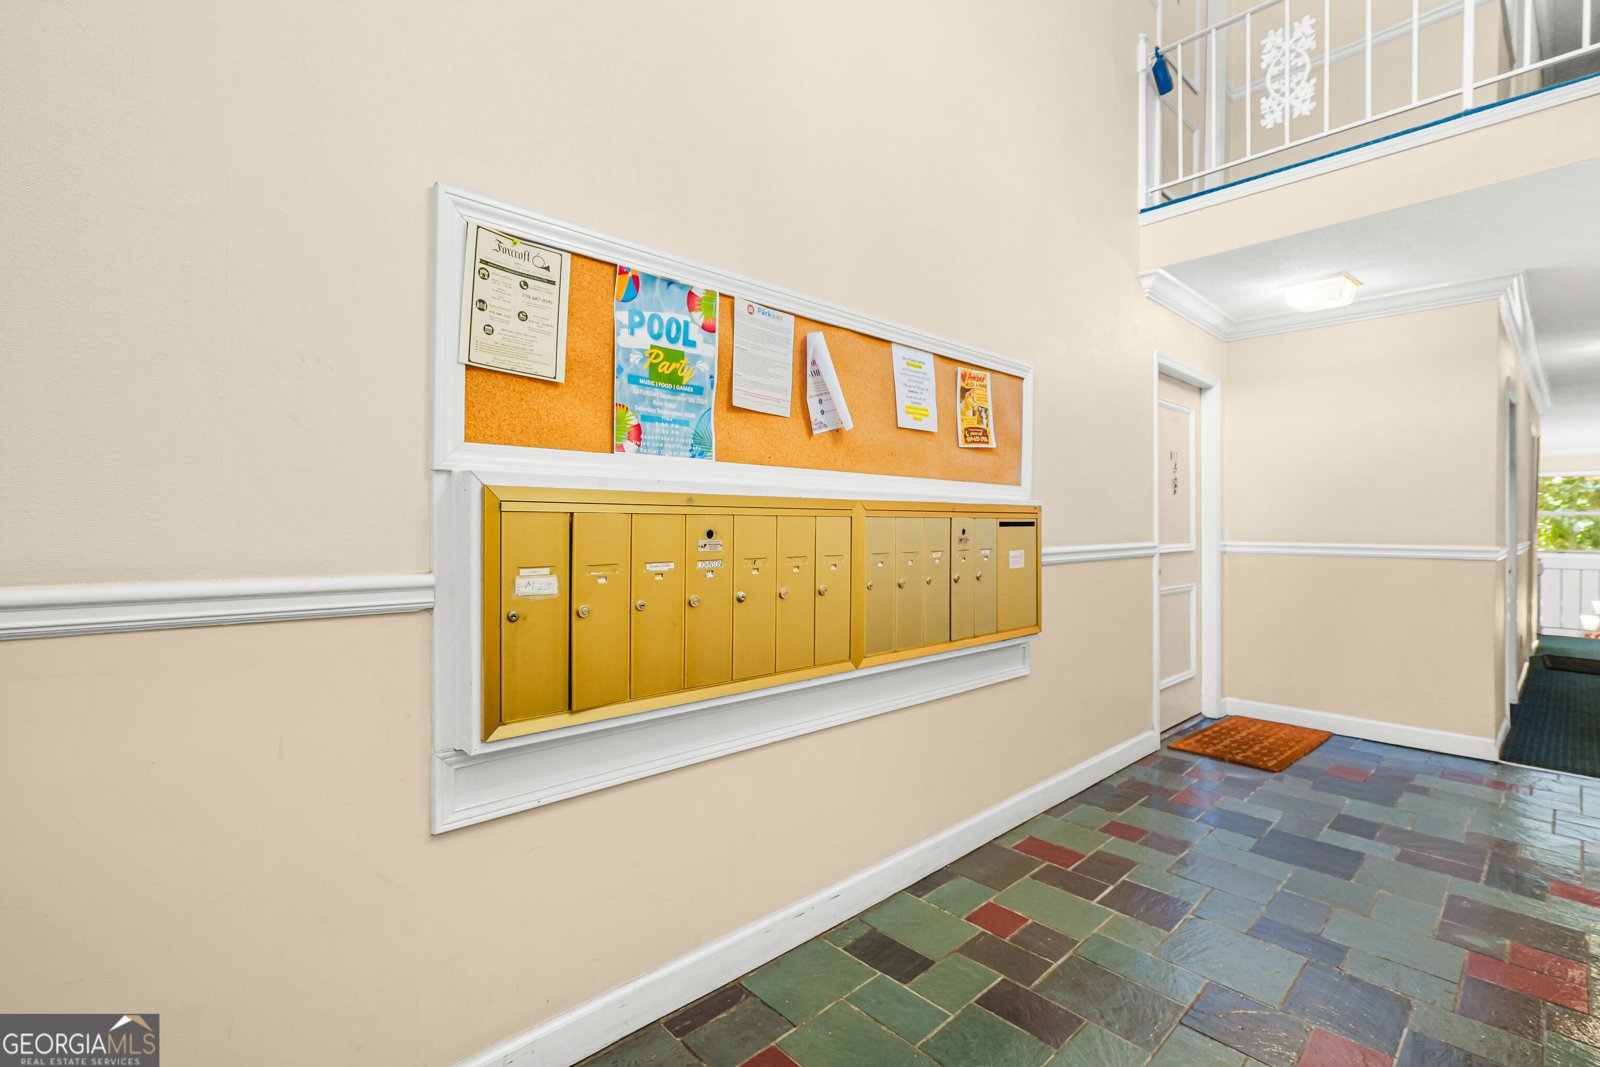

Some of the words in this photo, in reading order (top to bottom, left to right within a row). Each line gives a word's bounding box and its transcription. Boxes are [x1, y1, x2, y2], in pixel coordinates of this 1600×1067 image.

[492, 239, 531, 262] Foxcroft
[628, 309, 697, 348] POOL
[643, 348, 695, 386] Party
[639, 378, 655, 386] MUSIC
[676, 384, 694, 392] GAMES
